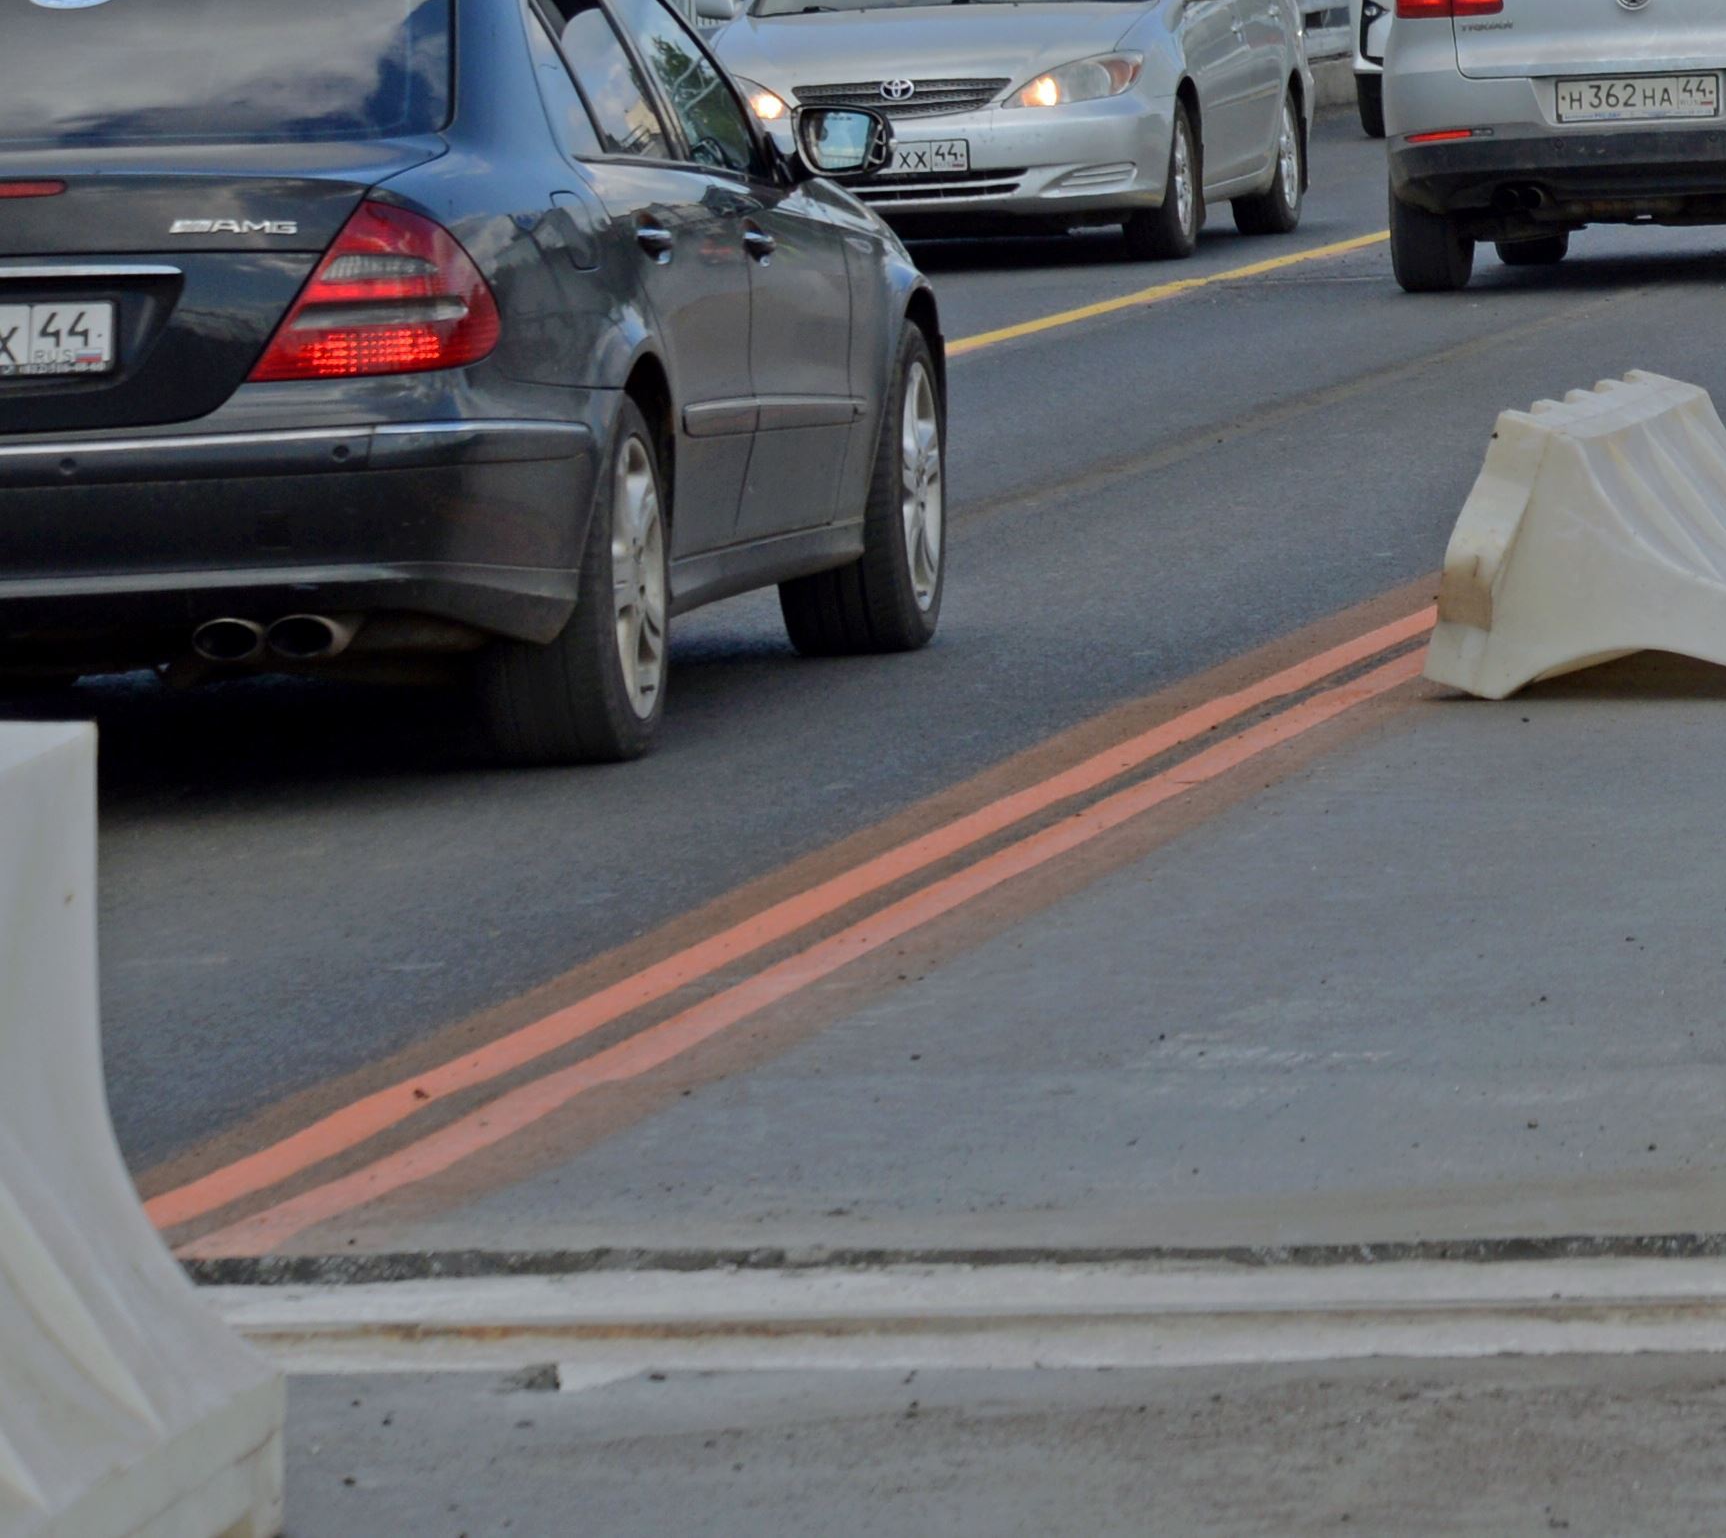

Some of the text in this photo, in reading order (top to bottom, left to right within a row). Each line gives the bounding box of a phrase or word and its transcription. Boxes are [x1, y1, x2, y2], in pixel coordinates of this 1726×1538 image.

[1682, 78, 1707, 98] 44
[934, 143, 958, 162] 44
[211, 219, 298, 235] AMG
[40, 311, 90, 347] 44
[33, 350, 73, 362] RUS
